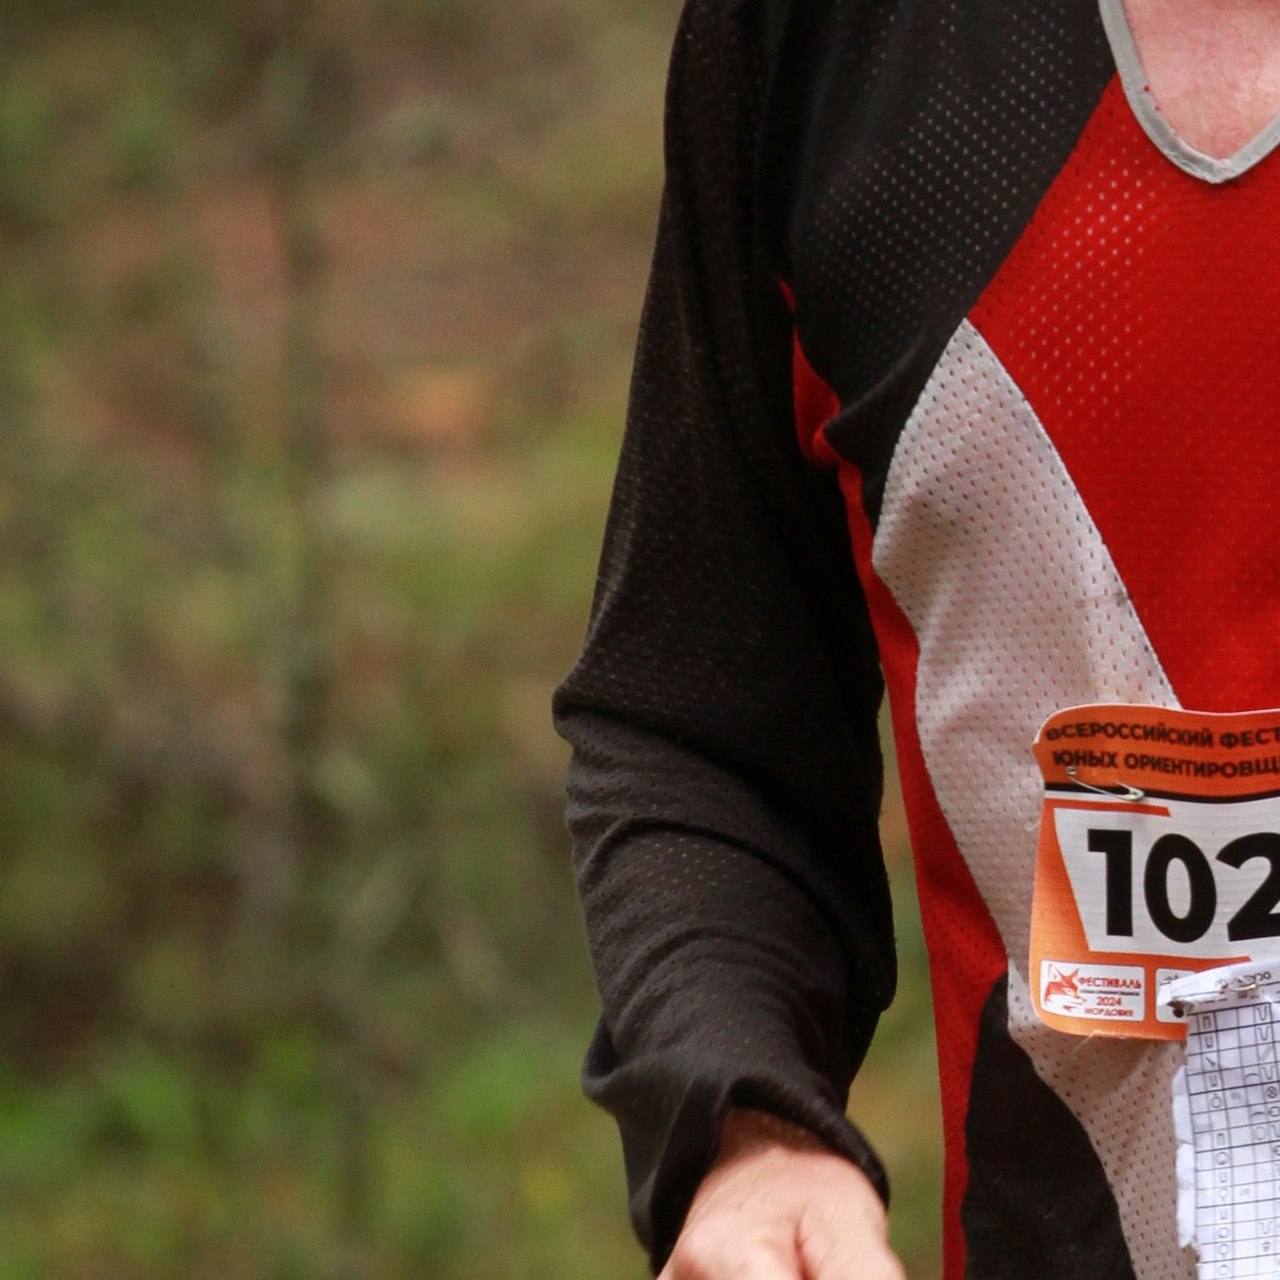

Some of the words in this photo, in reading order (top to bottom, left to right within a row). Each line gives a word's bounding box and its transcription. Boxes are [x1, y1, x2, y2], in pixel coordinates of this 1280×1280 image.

[1046, 721, 1213, 748] ВСЕРОССИЙСКИЙ
[1053, 749, 1118, 770] ЮНЫХ
[1078, 976, 1142, 989] ФЕСТИВАЛЬ
[1096, 996, 1122, 1006] 2024
[1084, 1007, 1134, 1017] МОРДОВИЯ
